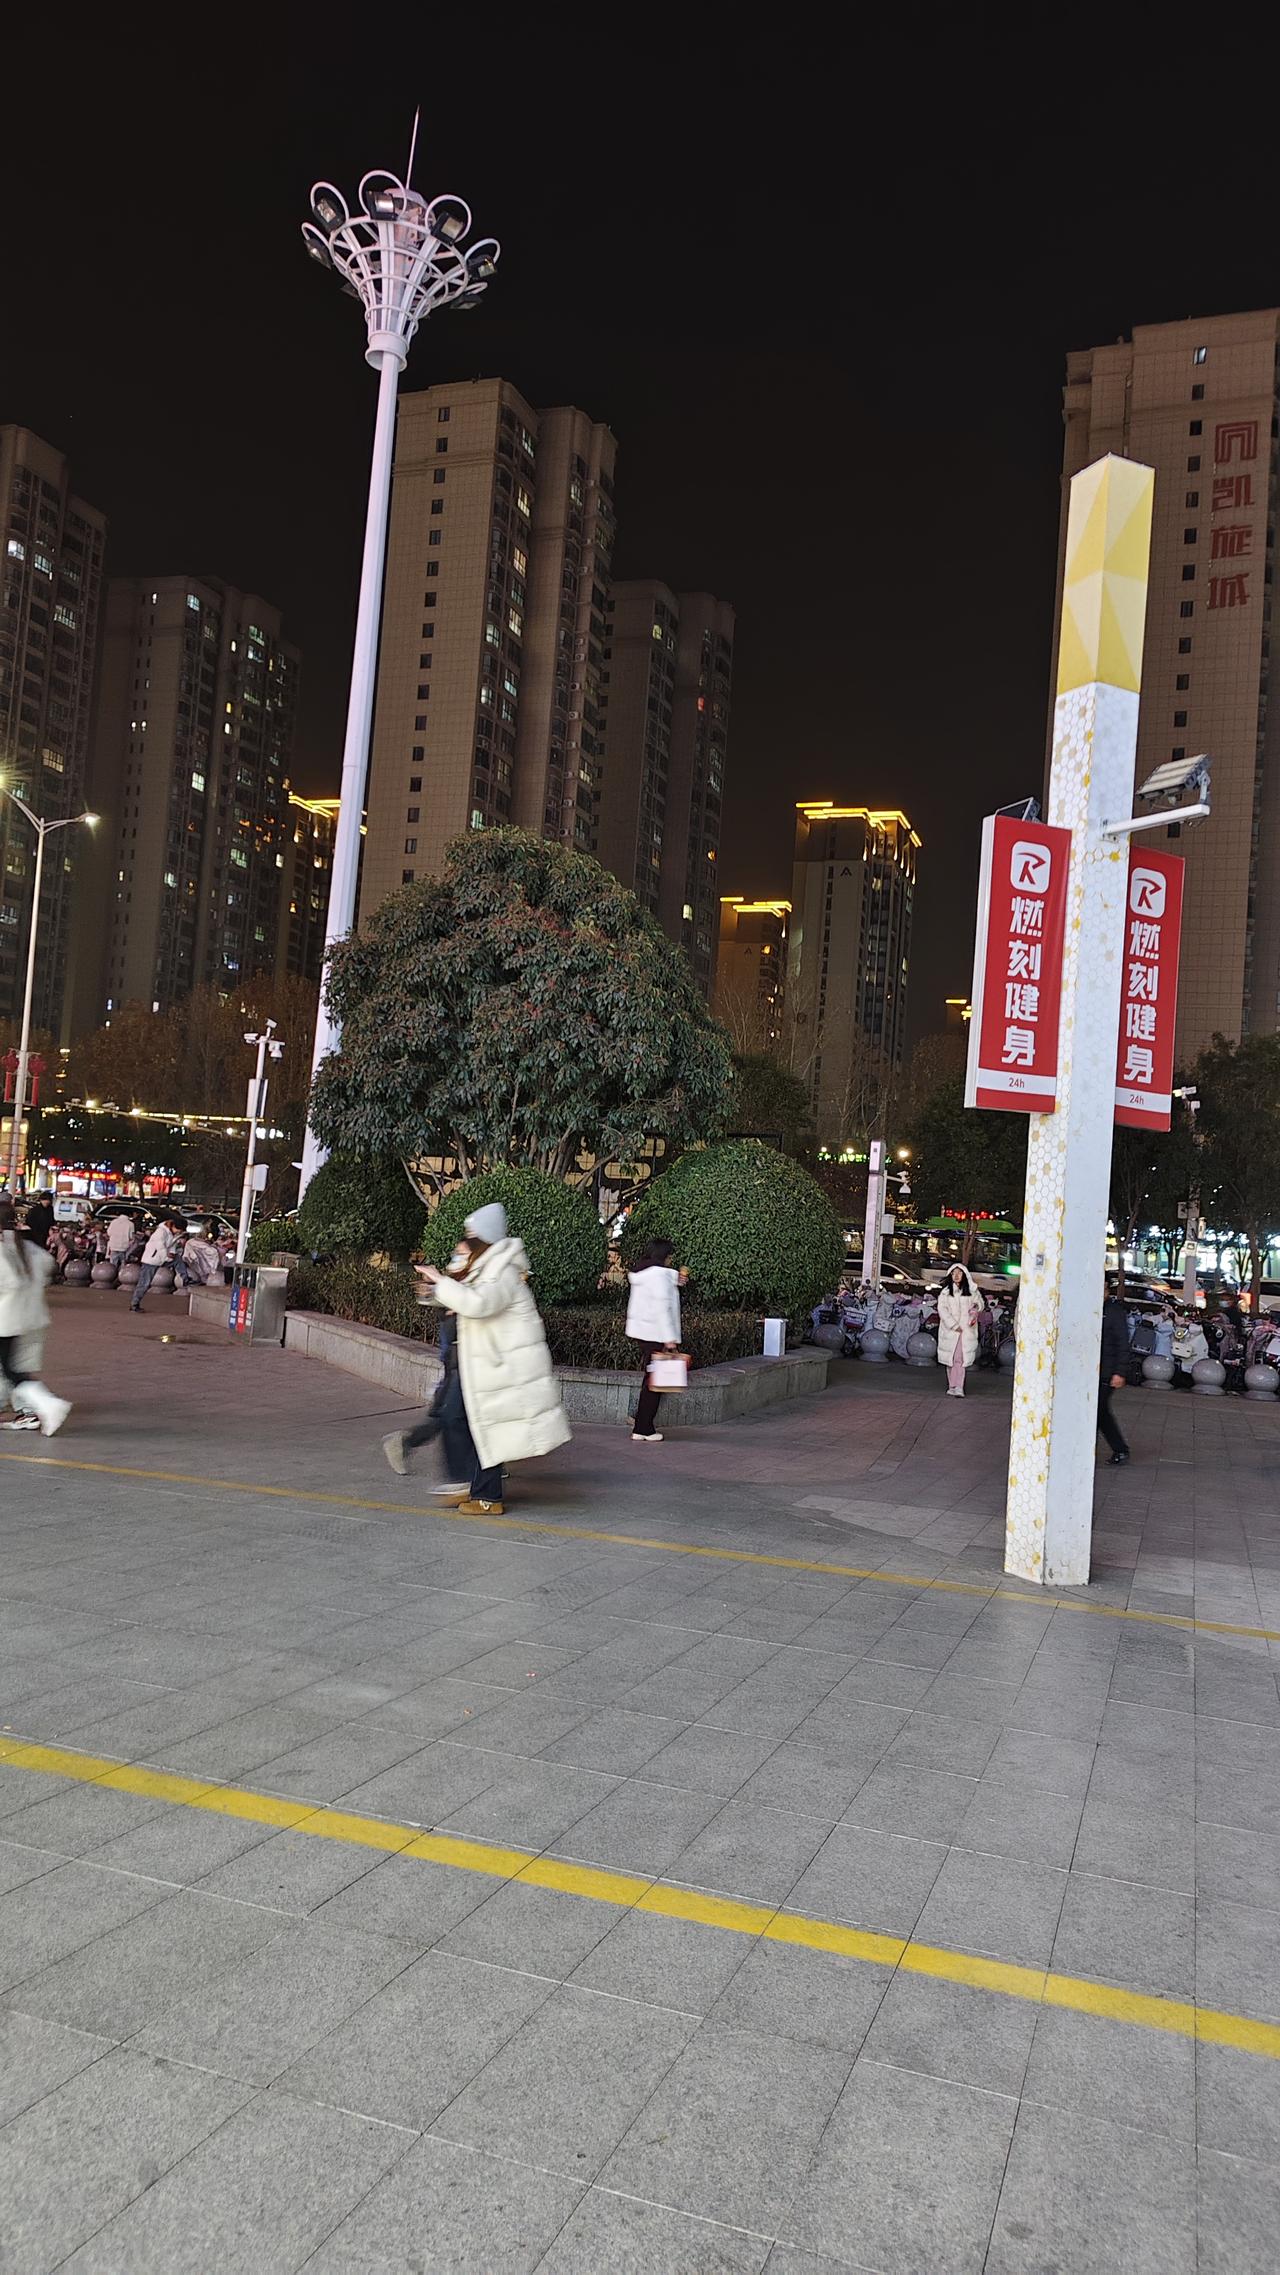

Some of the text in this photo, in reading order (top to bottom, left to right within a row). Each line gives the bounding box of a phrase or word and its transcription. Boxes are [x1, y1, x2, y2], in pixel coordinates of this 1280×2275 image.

[1001, 896, 1044, 1066] 燃刻健身
[1123, 920, 1161, 1084] 燃刻健身
[1008, 1077, 1025, 1089] 24h
[1129, 1094, 1144, 1106] 24h
